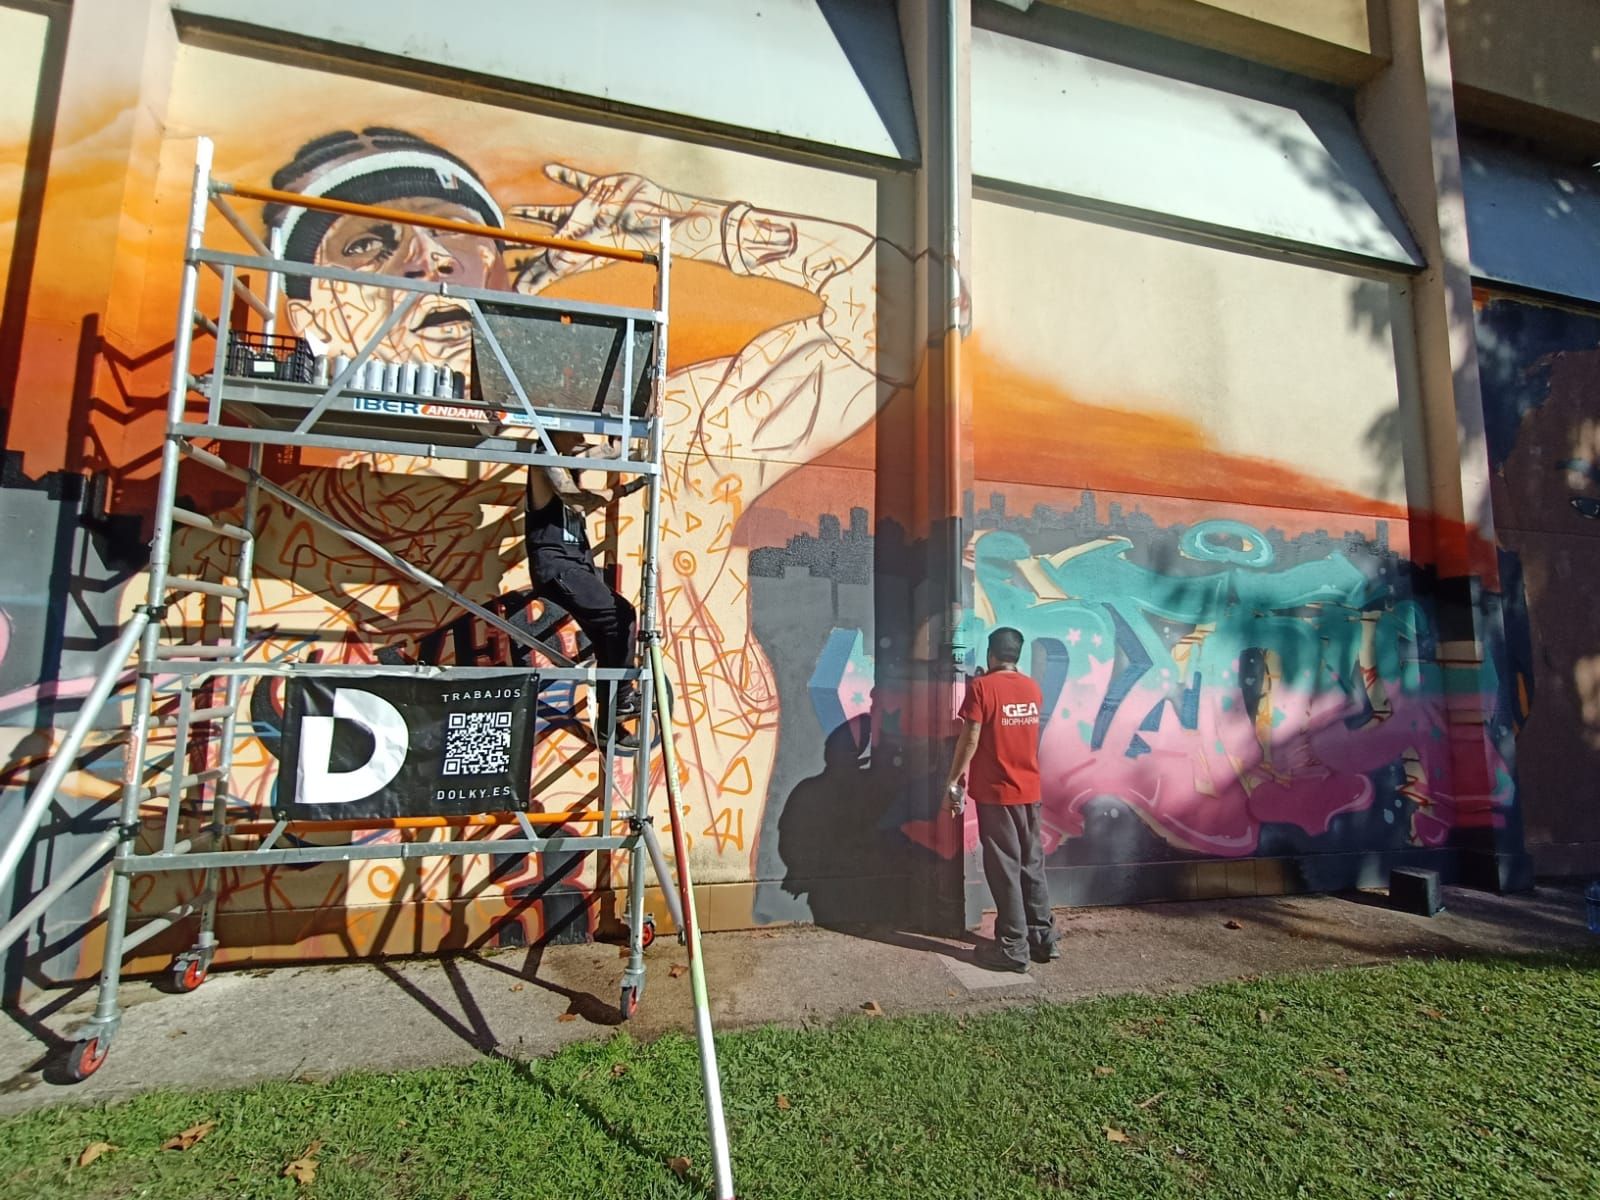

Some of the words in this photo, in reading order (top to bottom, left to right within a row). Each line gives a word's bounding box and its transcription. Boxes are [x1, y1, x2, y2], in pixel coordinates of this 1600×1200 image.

[355, 396, 418, 415] IBER
[441, 688, 521, 702] TRABAJOS
[437, 786, 512, 800] DOLKY.ES
